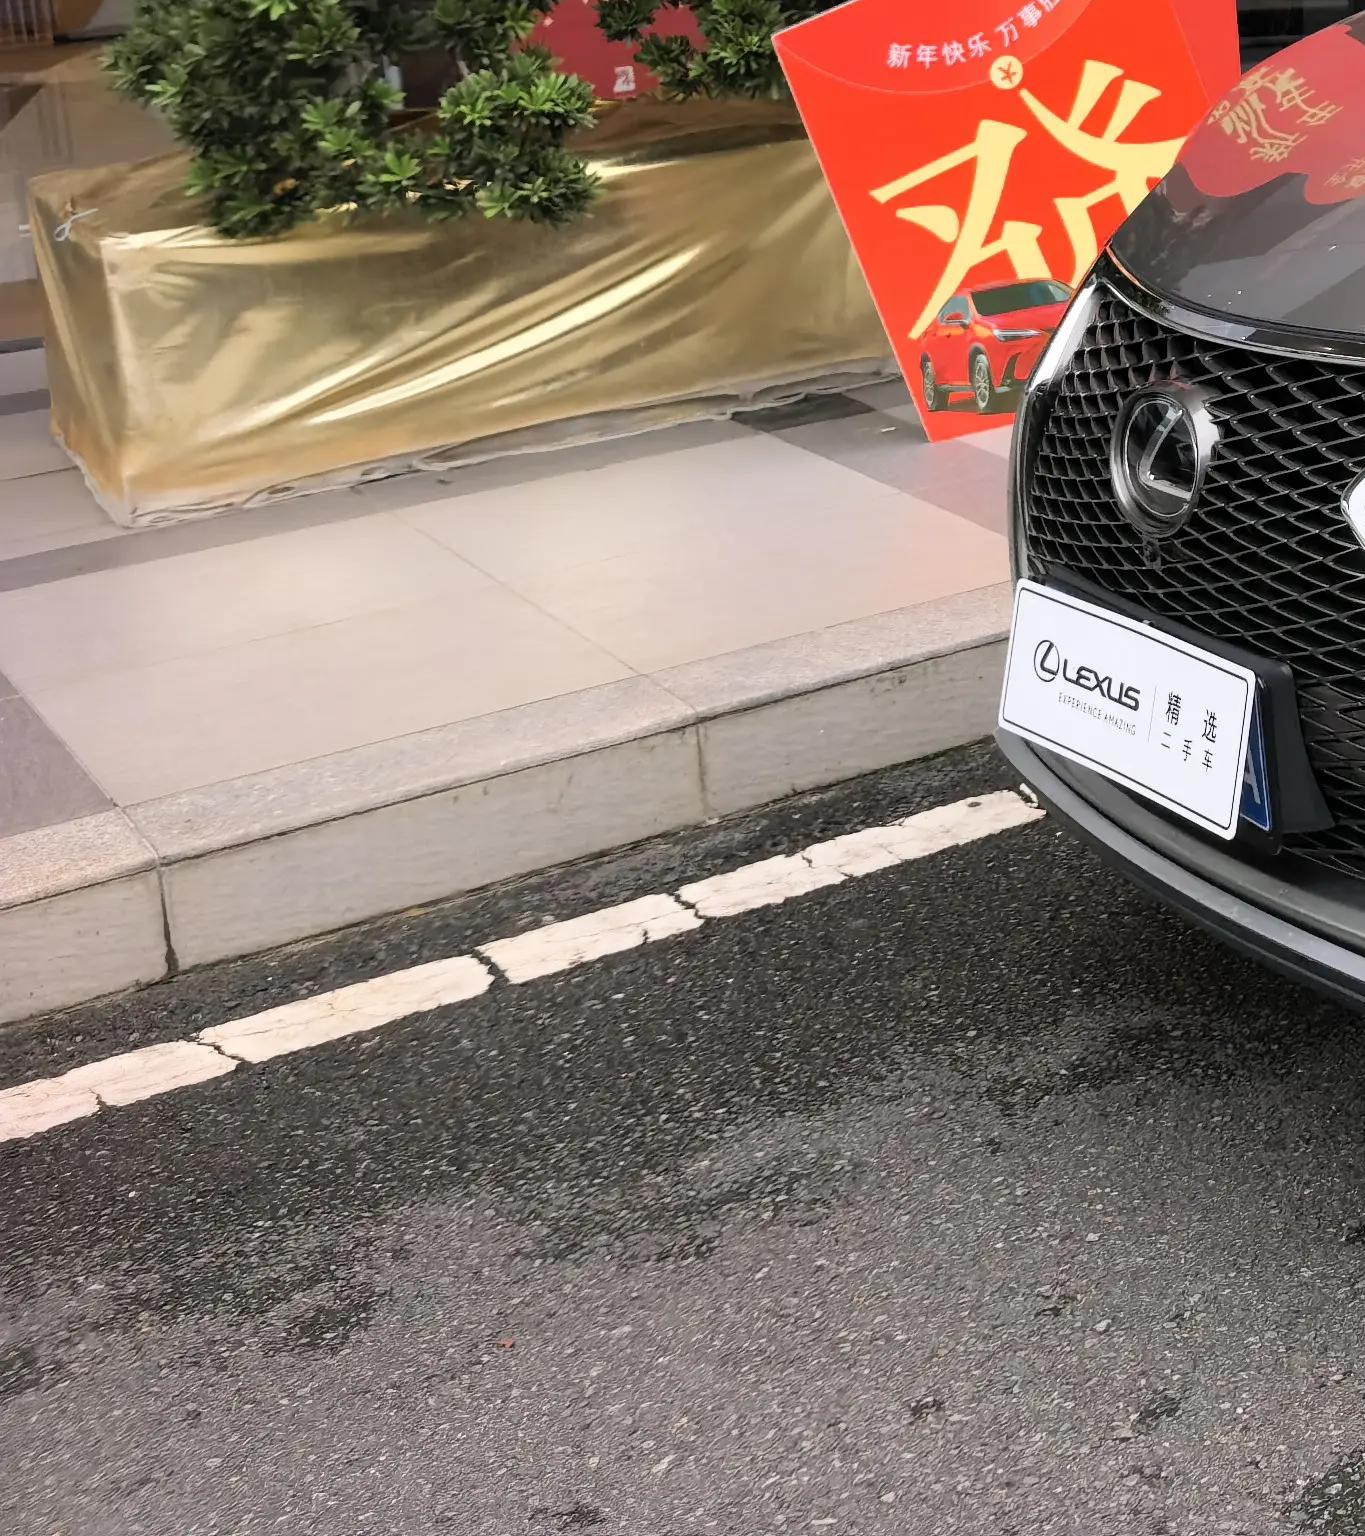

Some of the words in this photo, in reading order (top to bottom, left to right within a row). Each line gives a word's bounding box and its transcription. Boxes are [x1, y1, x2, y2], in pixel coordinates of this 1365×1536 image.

[887, 30, 994, 70] 新年快乐
[1062, 658, 1141, 712] LEXUS
[1058, 692, 1102, 720] EXPERIENCE
[1104, 713, 1137, 737] AMAZING
[1165, 691, 1218, 744] 精选
[1160, 731, 1214, 772] 二手车
